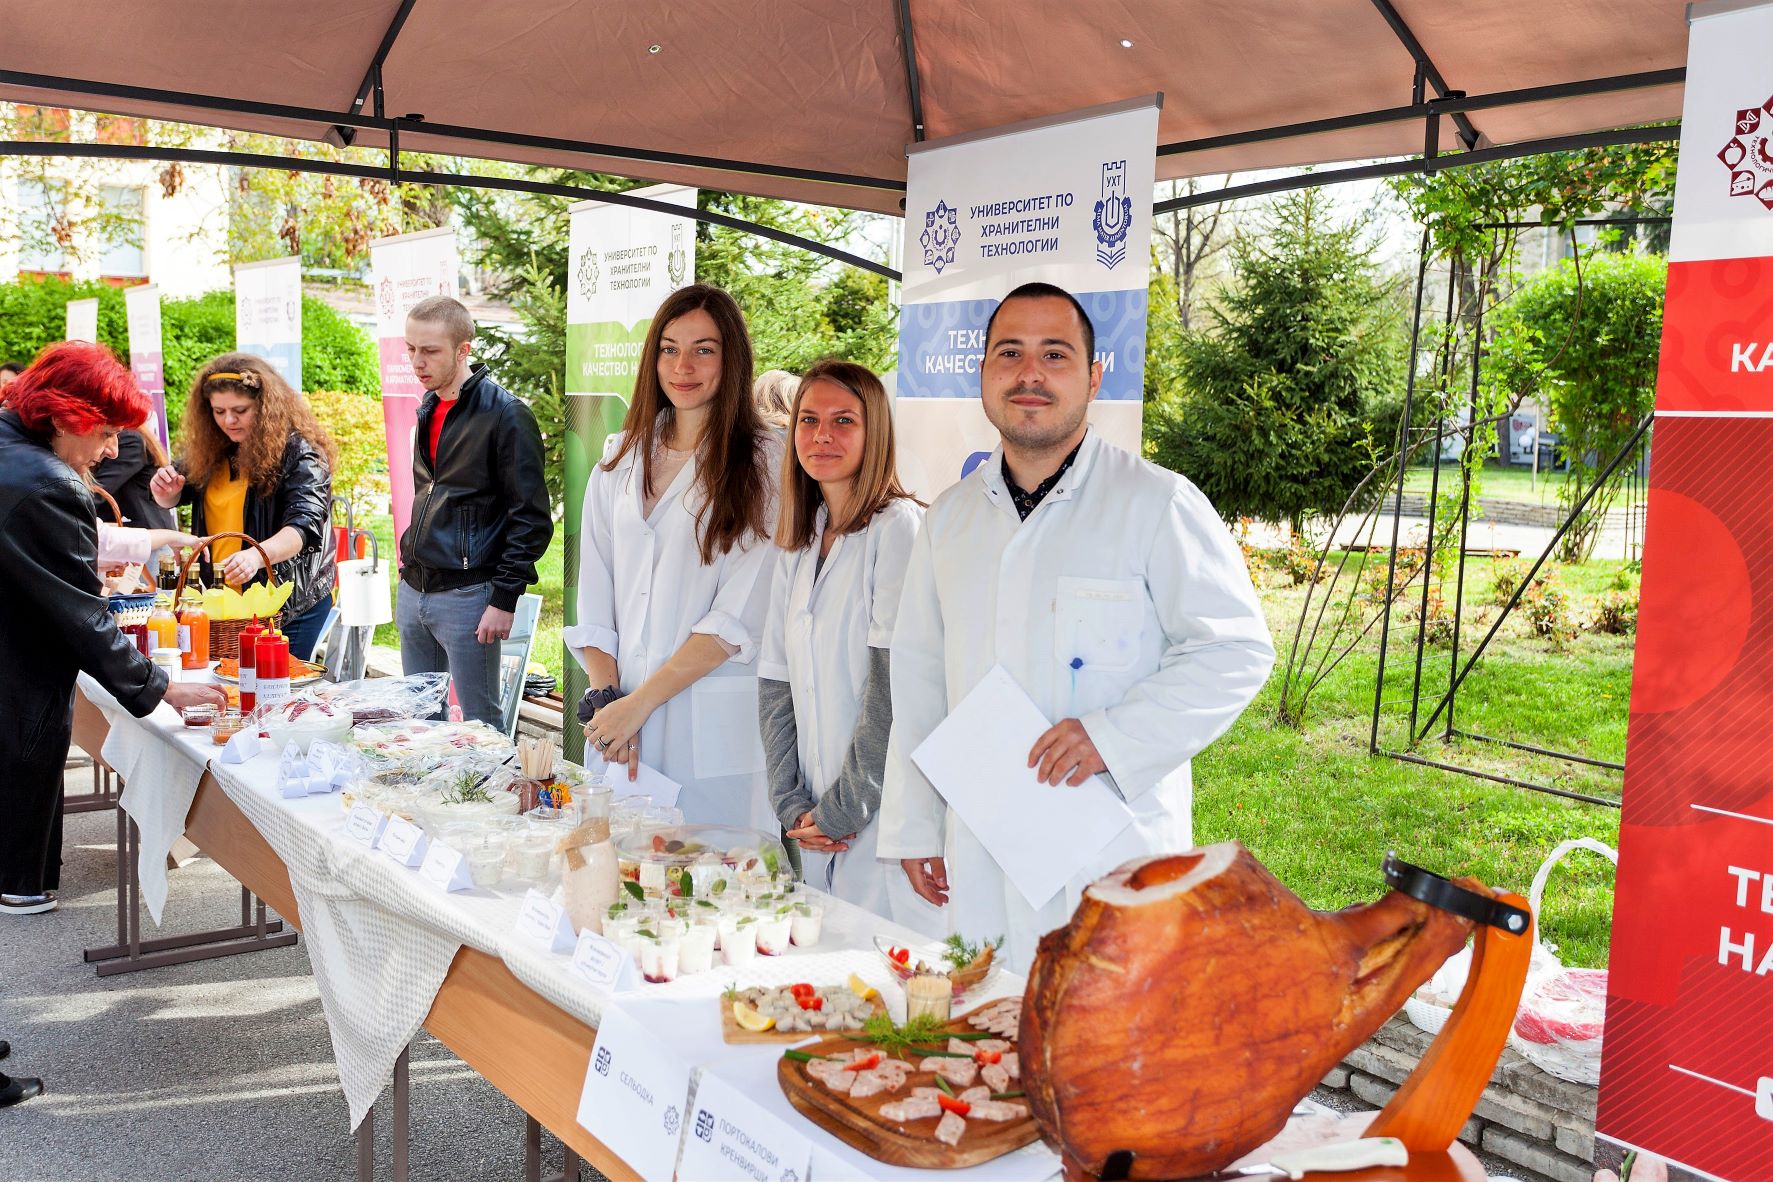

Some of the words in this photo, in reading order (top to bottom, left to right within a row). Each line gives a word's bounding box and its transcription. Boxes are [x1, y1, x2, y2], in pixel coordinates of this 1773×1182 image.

[1106, 174, 1121, 188] УХТ
[970, 196, 1053, 219] УНИВЕРСИТЕТ
[1055, 192, 1074, 208] ПО
[980, 215, 1060, 239] ХРАНИТЕЛНИ
[604, 246, 647, 262] УНИВЕРСИТЕТ
[648, 245, 657, 256] ПО
[980, 237, 1059, 258] ТЕХНОЛОГИИ
[610, 261, 651, 276] ХРАНИТЕЛНИ
[610, 276, 651, 291] ТЕХНОЛОГИИ
[582, 361, 629, 377] КАЧЕСТВО
[619, 1071, 654, 1106] СЕЛЬОДКА
[719, 1118, 779, 1168] ПОРТОКАЛОВИ
[720, 1143, 769, 1182] КРЕНВИРШИ
